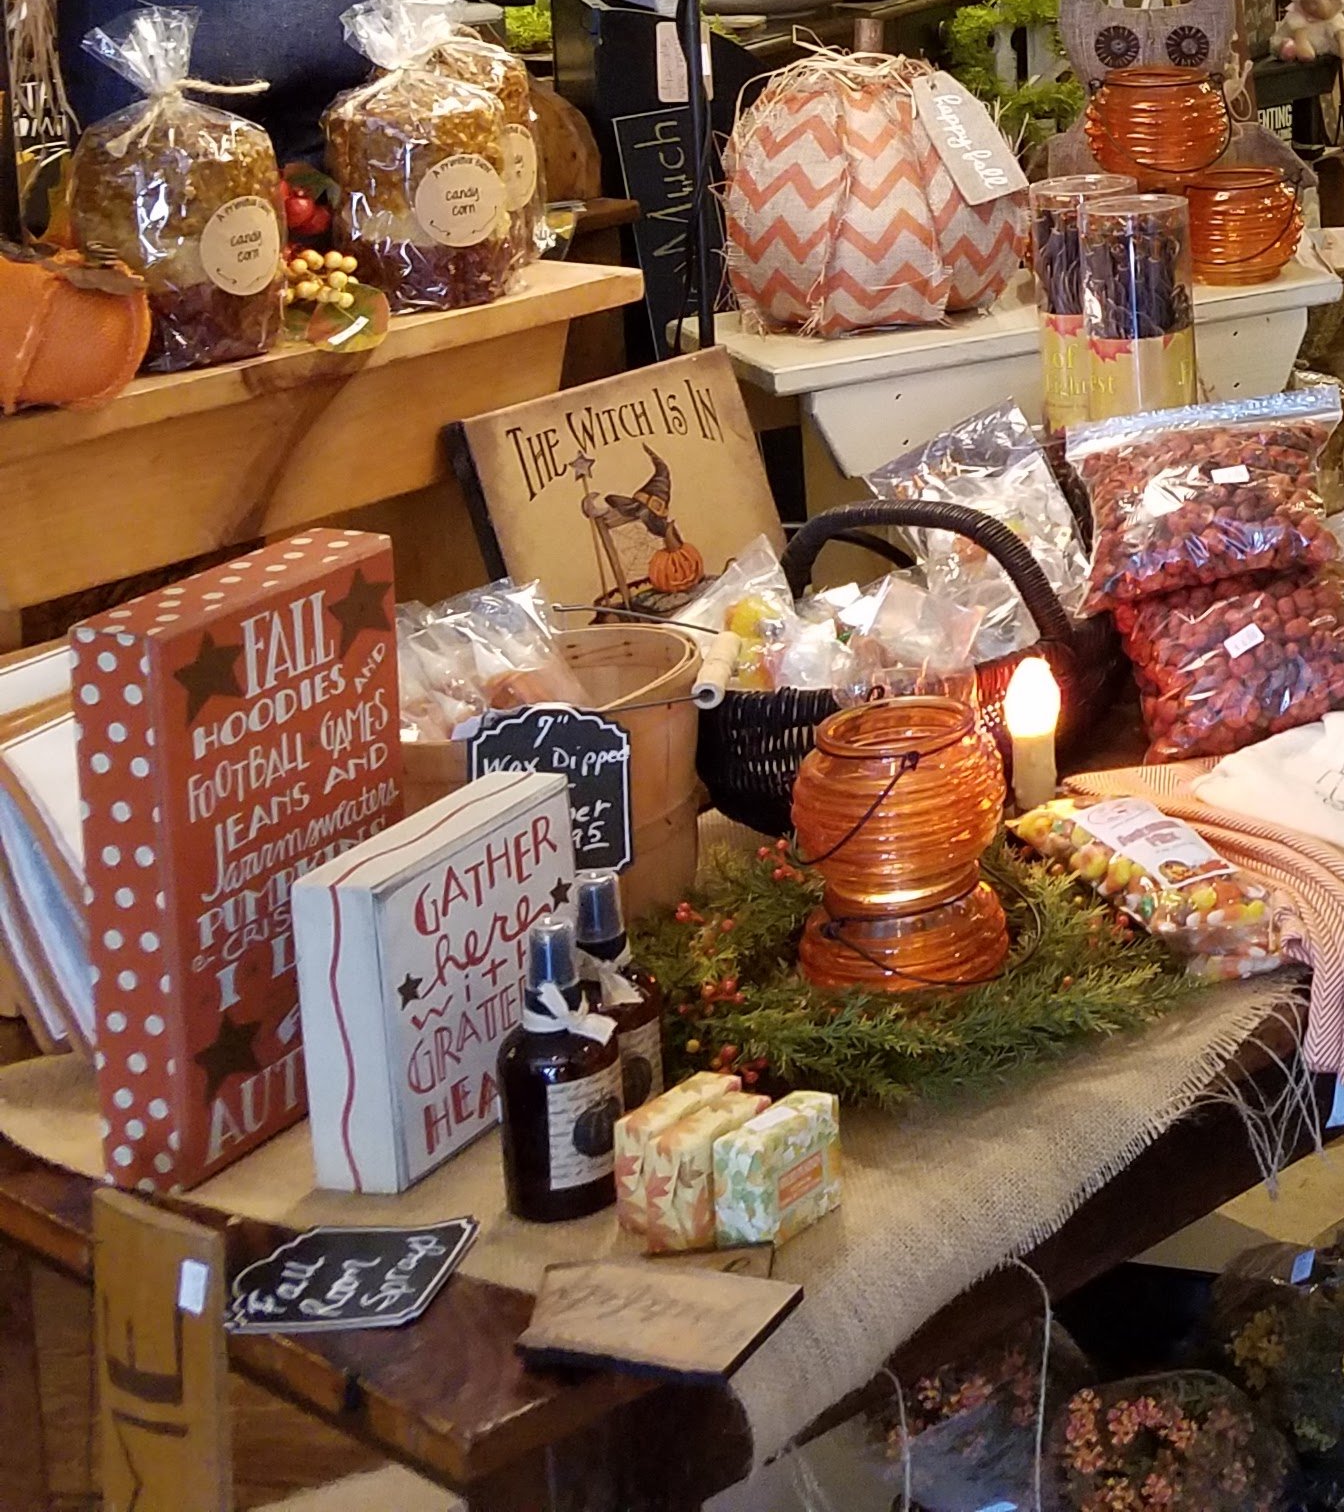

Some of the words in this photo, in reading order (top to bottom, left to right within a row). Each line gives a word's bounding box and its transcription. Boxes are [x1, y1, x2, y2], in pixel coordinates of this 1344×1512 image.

[932, 91, 973, 157] happy
[963, 138, 1010, 189] fall
[230, 230, 262, 249] candy
[446, 186, 480, 204] candy
[452, 202, 477, 217] corn
[237, 247, 260, 264] corn
[506, 427, 568, 501] THE
[567, 402, 652, 458] WITCH
[656, 395, 688, 438] IS
[683, 379, 724, 444] IN
[242, 589, 335, 700] FALL
[193, 663, 347, 760] HOODIES
[354, 642, 387, 696] AND
[187, 731, 311, 824] FOOTBALL
[321, 688, 390, 759] GAMES
[552, 746, 630, 776] Dipped
[201, 782, 311, 903] JEANS
[324, 743, 389, 795] AND
[302, 777, 400, 855] sweaters
[413, 815, 558, 938] GATHER
[221, 903, 293, 961] CRIS
[420, 893, 553, 1000] here
[407, 973, 527, 1096] GRATE
[206, 1044, 305, 1165] AUT
[248, 1256, 326, 1315] Fall
